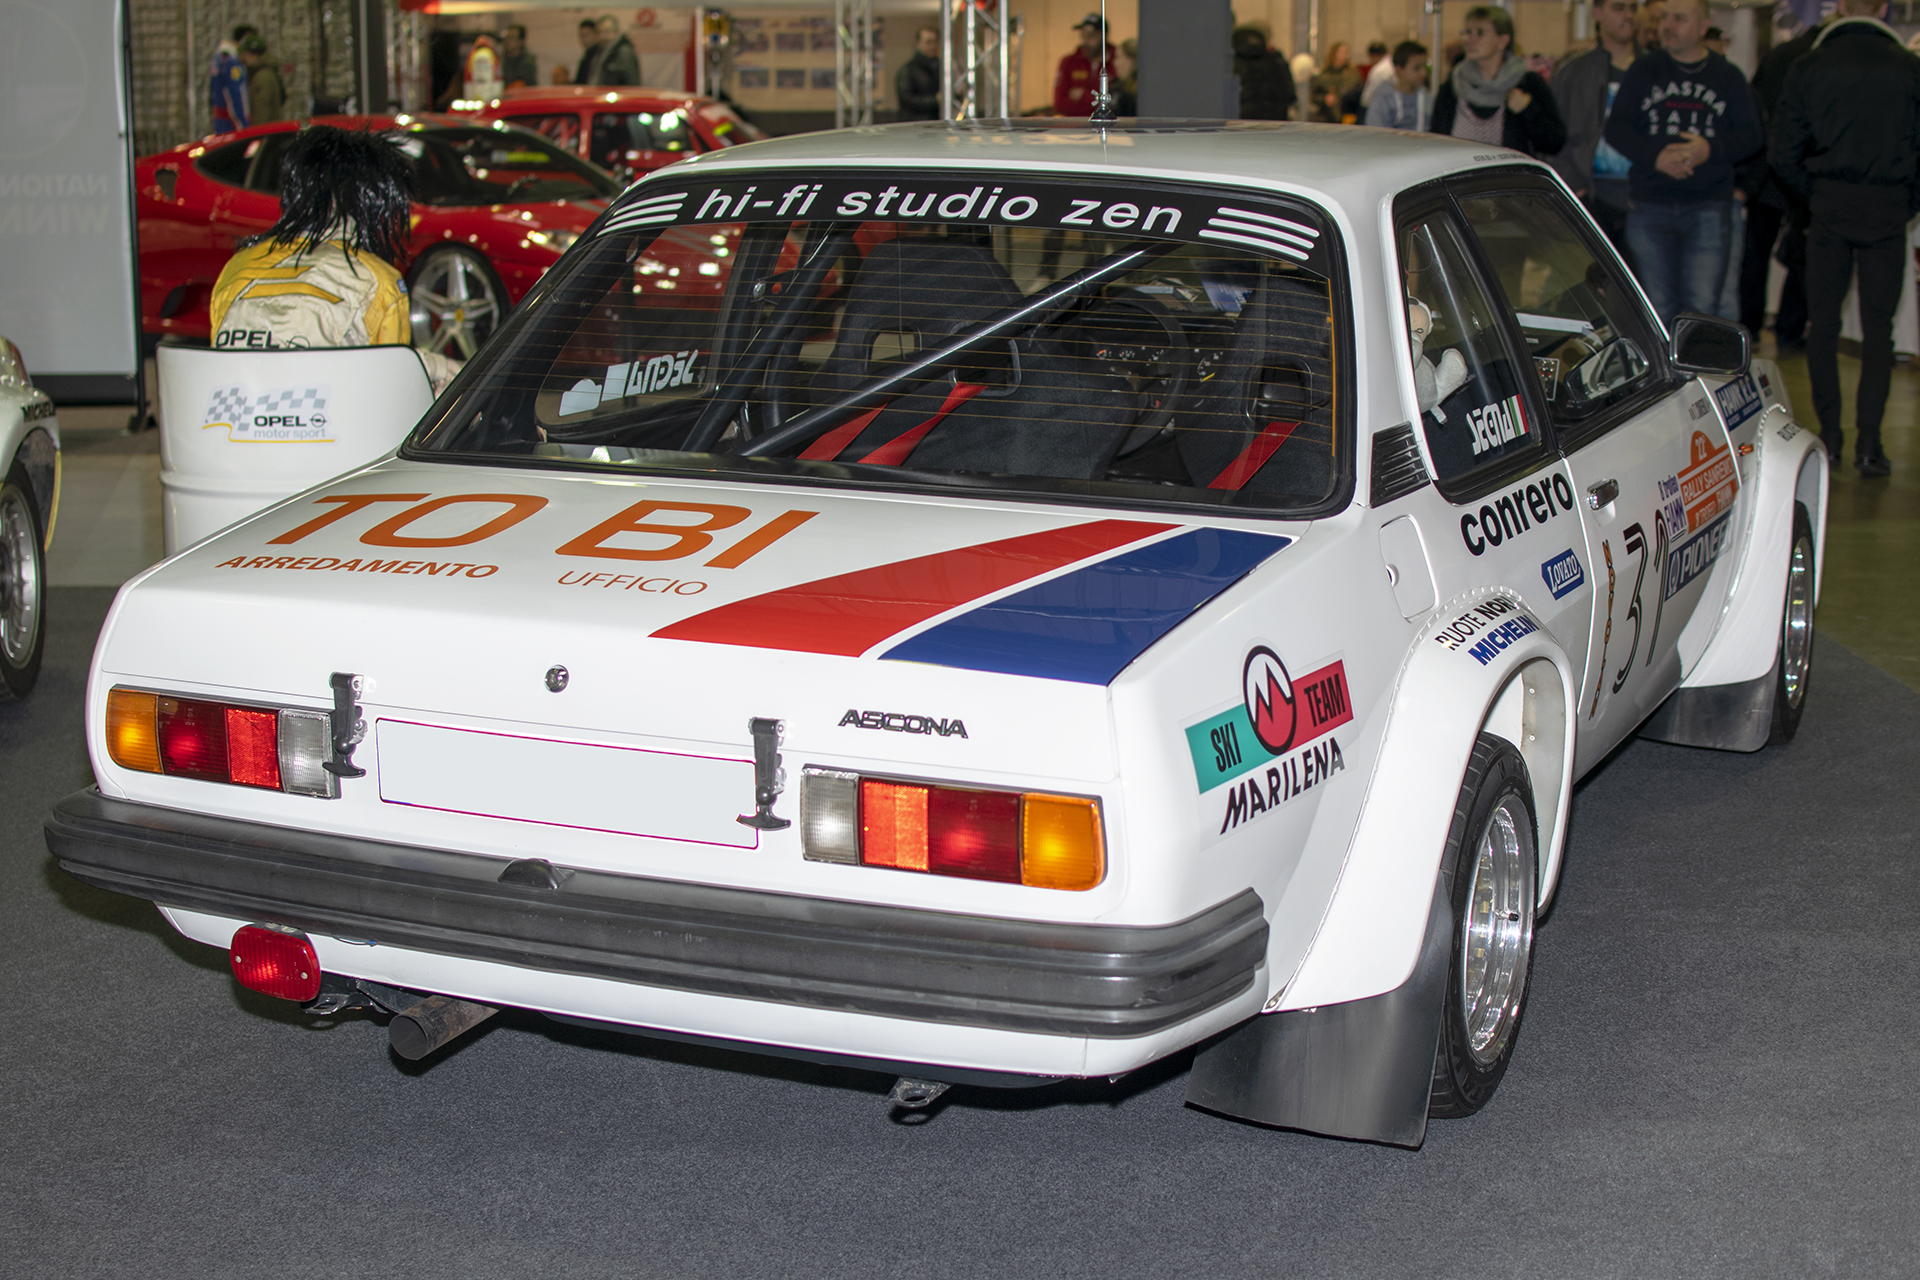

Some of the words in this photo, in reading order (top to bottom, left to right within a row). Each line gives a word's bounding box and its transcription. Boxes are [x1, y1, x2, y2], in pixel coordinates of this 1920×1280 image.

[695, 184, 823, 220] hi-fi
[836, 185, 1038, 222] studio
[1060, 198, 1182, 234] zen
[215, 329, 280, 349] OPEL
[253, 415, 307, 427] OPEL
[265, 492, 549, 548] TO
[555, 498, 820, 569] BI
[1459, 472, 1574, 557] conrero
[214, 555, 500, 579] ARREDAMENTO
[557, 570, 709, 597] UFFICIO
[1546, 554, 1578, 594] LOVATO
[1434, 612, 1487, 652] RUOTE
[1467, 613, 1541, 667] MICHELIN
[837, 708, 969, 739] ASCONA
[1210, 721, 1243, 773] SKI
[1303, 672, 1346, 728] TEAM
[1219, 736, 1346, 836] MARILENA
